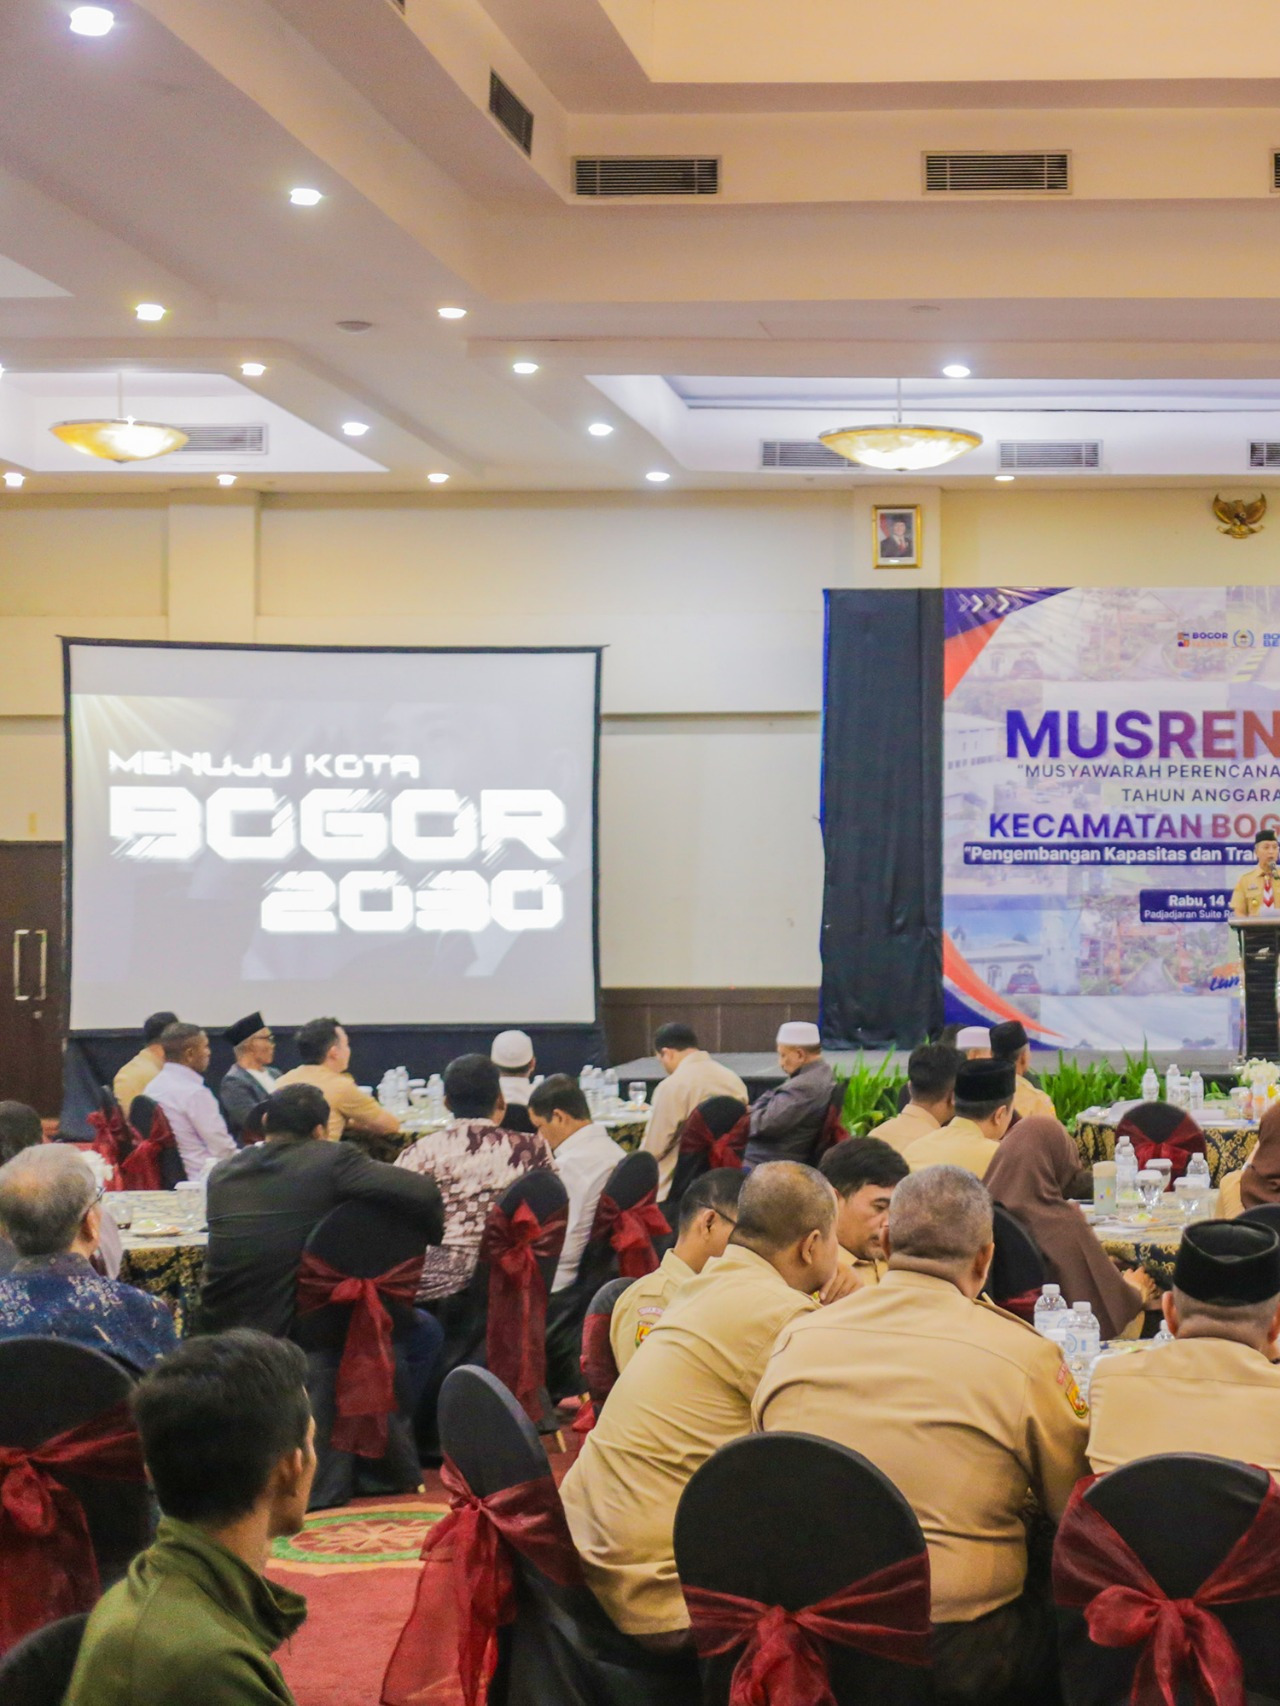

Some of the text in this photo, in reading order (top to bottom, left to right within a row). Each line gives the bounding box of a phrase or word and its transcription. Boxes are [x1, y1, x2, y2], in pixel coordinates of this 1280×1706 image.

[108, 749, 420, 779] MENUJU KOTA
[1121, 788, 1185, 802] TAHUN
[108, 785, 567, 863] BOGOR
[988, 812, 1202, 839] KECAMATAN
[1104, 845, 1188, 864] Kapasitas
[1191, 845, 1221, 861] dan
[260, 869, 565, 933] 2030
[1168, 894, 1207, 908] Rabu,
[1209, 894, 1226, 907] 14
[1144, 909, 1197, 920] Padjadjaran
[1199, 909, 1222, 919] Suite
